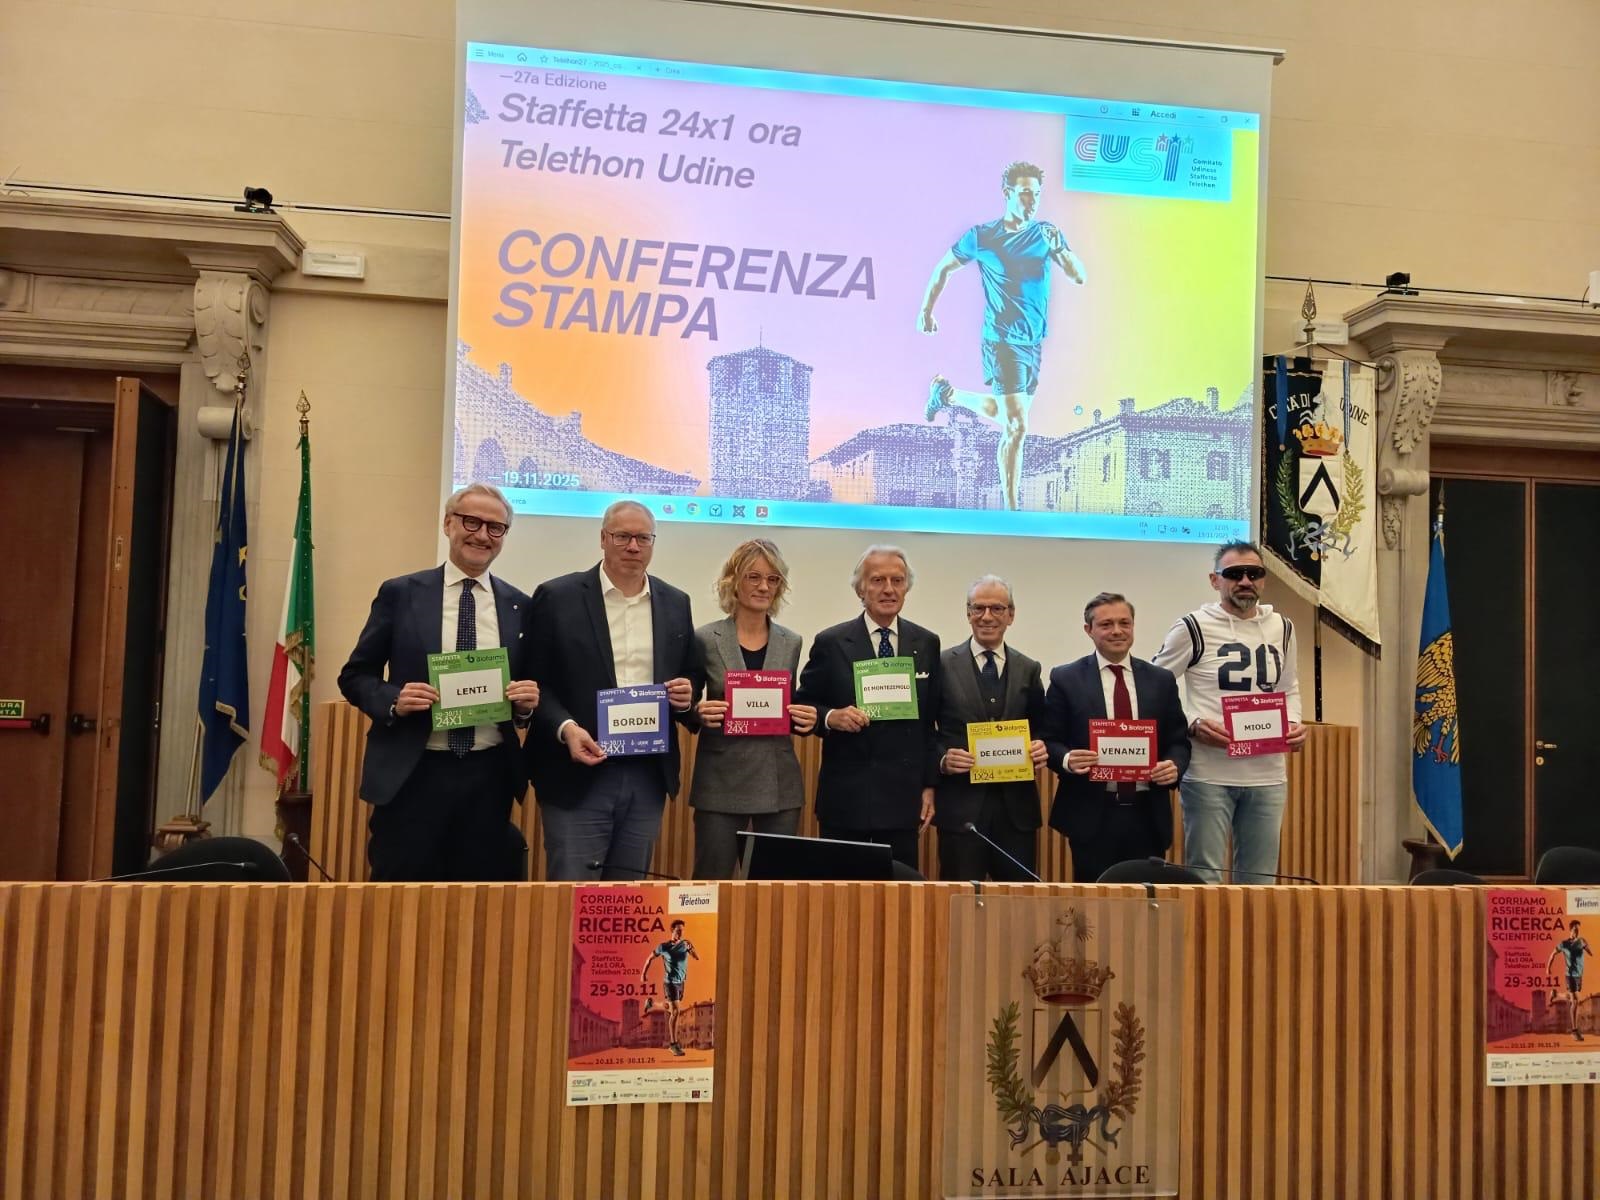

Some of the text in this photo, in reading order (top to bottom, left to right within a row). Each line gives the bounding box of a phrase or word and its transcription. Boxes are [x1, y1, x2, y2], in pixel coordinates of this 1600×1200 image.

[545, 73, 607, 90] Edizione
[498, 92, 802, 147] Staffetta 24x1 ora
[1150, 110, 1177, 120] Accedi
[501, 139, 755, 189] Telethon Udine
[498, 229, 876, 300] CONFERENZA
[492, 281, 719, 341] STAMPA
[1217, 642, 1282, 693] 20
[456, 685, 488, 696] LENTI
[435, 715, 464, 728] 24X1
[613, 717, 656, 727] BORDIN
[728, 725, 748, 734] 24X1
[1244, 723, 1272, 731] MIOLO
[993, 749, 1022, 757] ECCHER
[1101, 747, 1146, 755] VENANZI
[1231, 747, 1252, 756] 24X1
[974, 771, 994, 780] 1X24
[1092, 772, 1113, 780] 24X1
[581, 895, 643, 904] CORRIAMO
[679, 894, 710, 906] Telethon
[1492, 897, 1546, 906] CORRIAMO
[580, 906, 664, 915] ASSIEME ALLA
[1491, 906, 1563, 915] ASSIEME ALLA
[579, 917, 665, 932] RICERCA
[1492, 917, 1565, 931] RICERCA
[578, 934, 650, 944] SCIENTIFICA
[1492, 932, 1553, 941] SCIENTIFICA
[1504, 976, 1560, 988] 29-30.11
[590, 983, 658, 996] 29-30.11
[971, 1165, 1150, 1187] SALA AJACE
